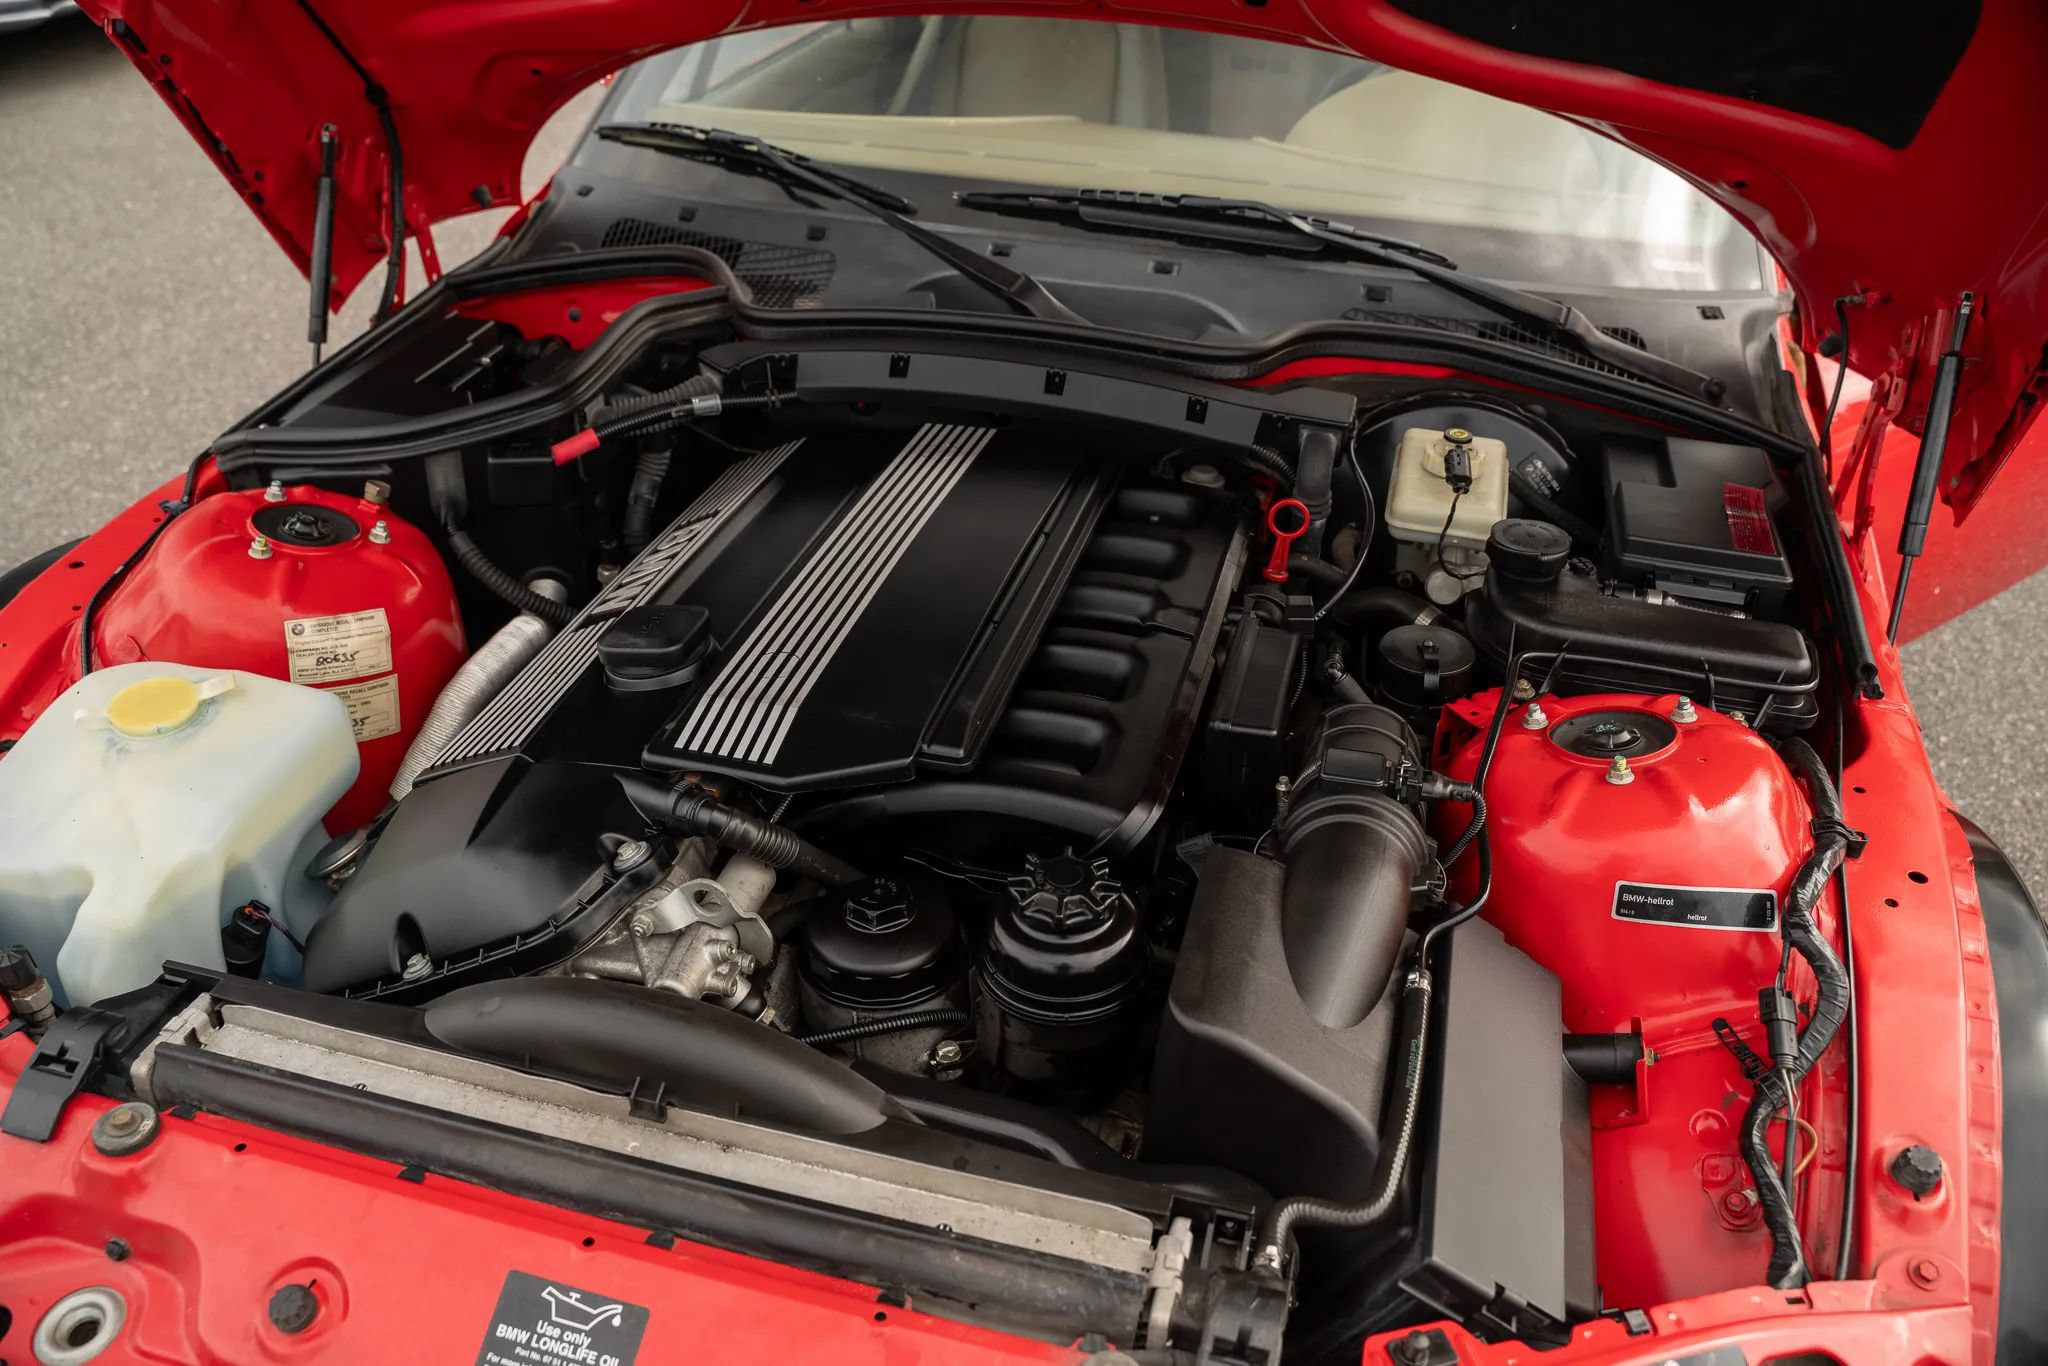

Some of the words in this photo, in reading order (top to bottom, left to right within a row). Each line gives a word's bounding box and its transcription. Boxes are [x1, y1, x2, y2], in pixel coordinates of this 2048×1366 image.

[591, 517, 713, 614] BMW
[354, 615, 375, 624] CAMPAIGN
[1622, 893, 1674, 906] BMW-hellrot
[1687, 913, 1708, 922] hellrot
[536, 1320, 561, 1339] Use
[562, 1331, 592, 1348] only
[495, 1323, 531, 1344] BMW
[530, 1334, 598, 1365] LONGLIFE
[486, 1352, 499, 1364] For
[514, 1346, 531, 1356] Part
[530, 1351, 542, 1362] No.
